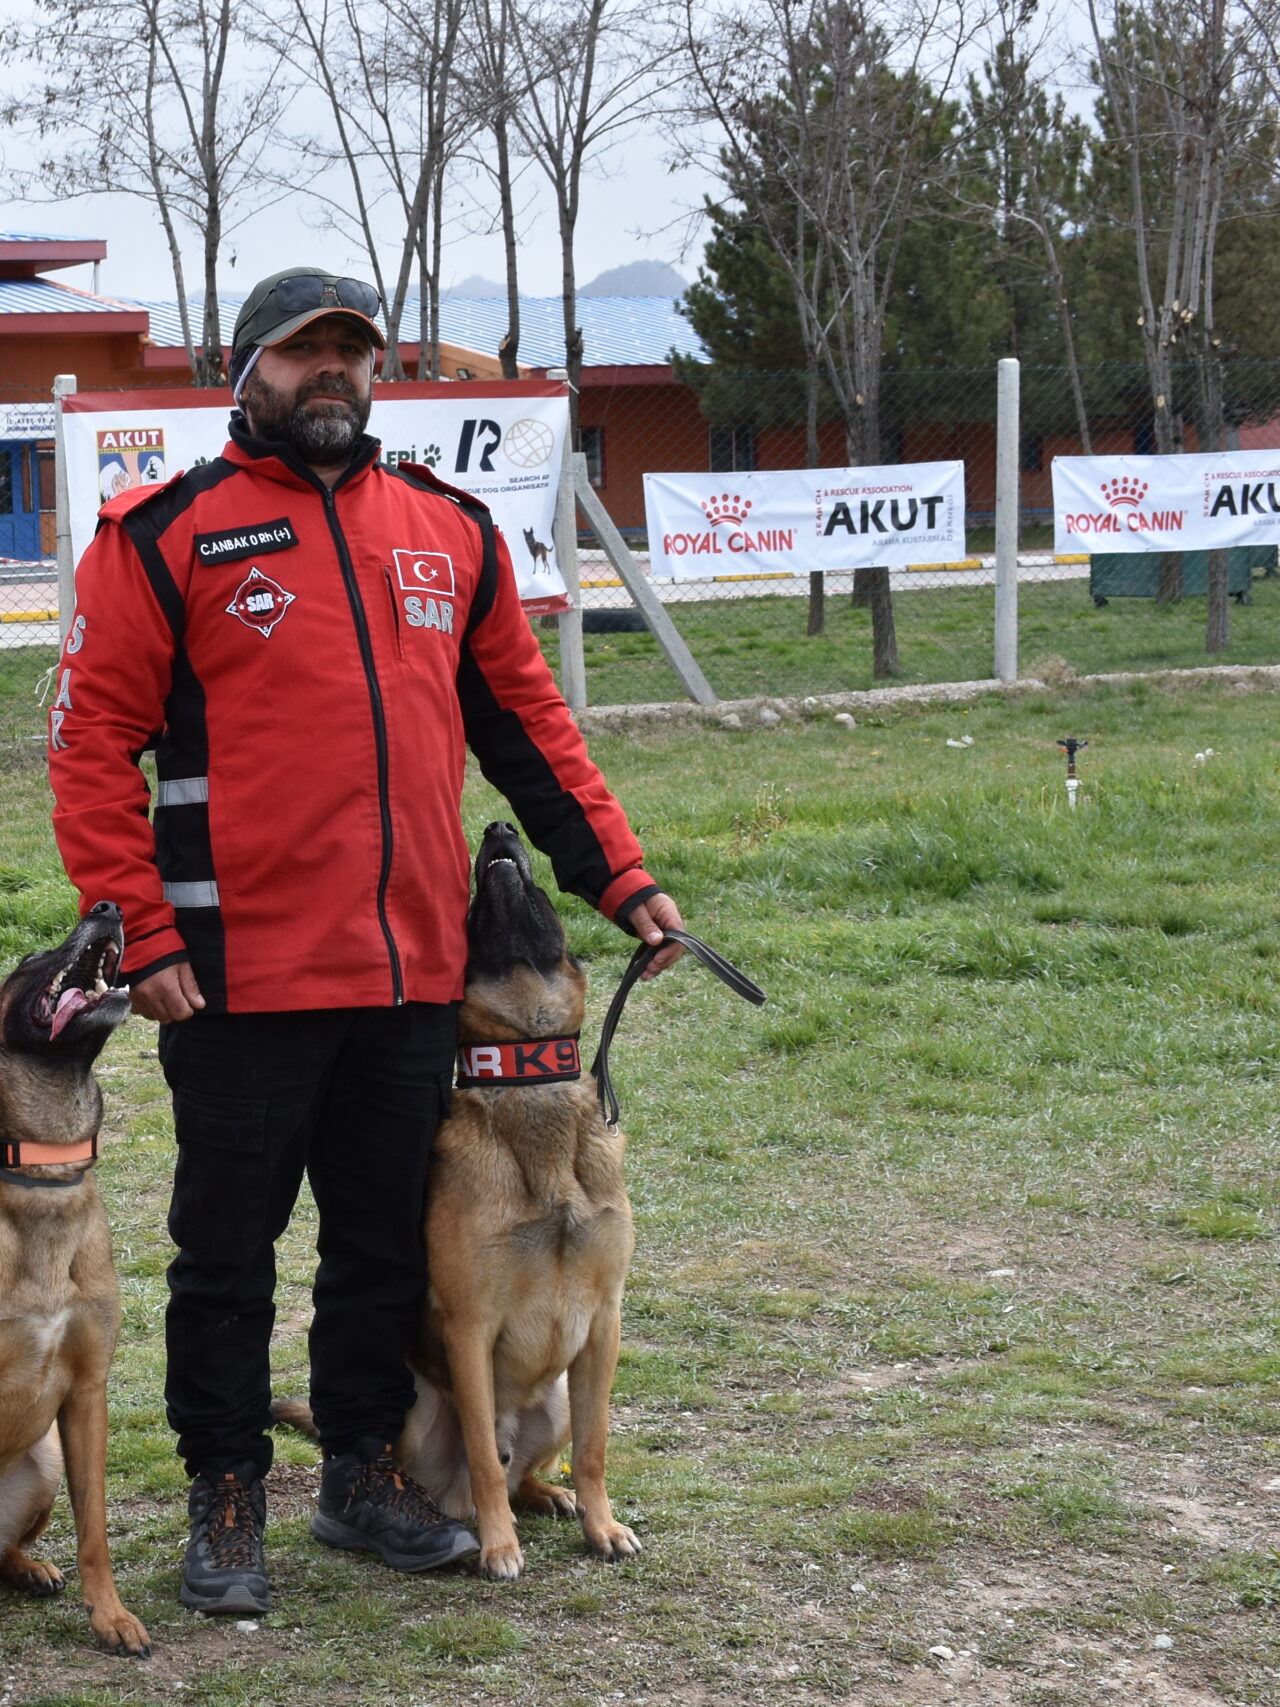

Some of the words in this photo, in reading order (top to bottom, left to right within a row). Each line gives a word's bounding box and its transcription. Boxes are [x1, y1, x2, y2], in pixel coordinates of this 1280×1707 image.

[102, 430, 160, 448] AKUT
[482, 486, 499, 494] DOG
[509, 475, 541, 484] SEARCH
[830, 487, 860, 496] RESCUE
[861, 485, 913, 495] ASSOCIATION
[815, 489, 823, 536] SEARCH
[823, 495, 944, 536] AKUT
[1065, 512, 1122, 534] ROYAL
[1127, 510, 1184, 533] CANIN
[258, 531, 274, 544] Rh
[273, 527, 291, 542] (+)
[663, 531, 723, 556] ROYAL
[727, 528, 793, 553] CANIN
[246, 592, 275, 612] SAR
[404, 596, 454, 635] SAR
[514, 1041, 576, 1075] K9
